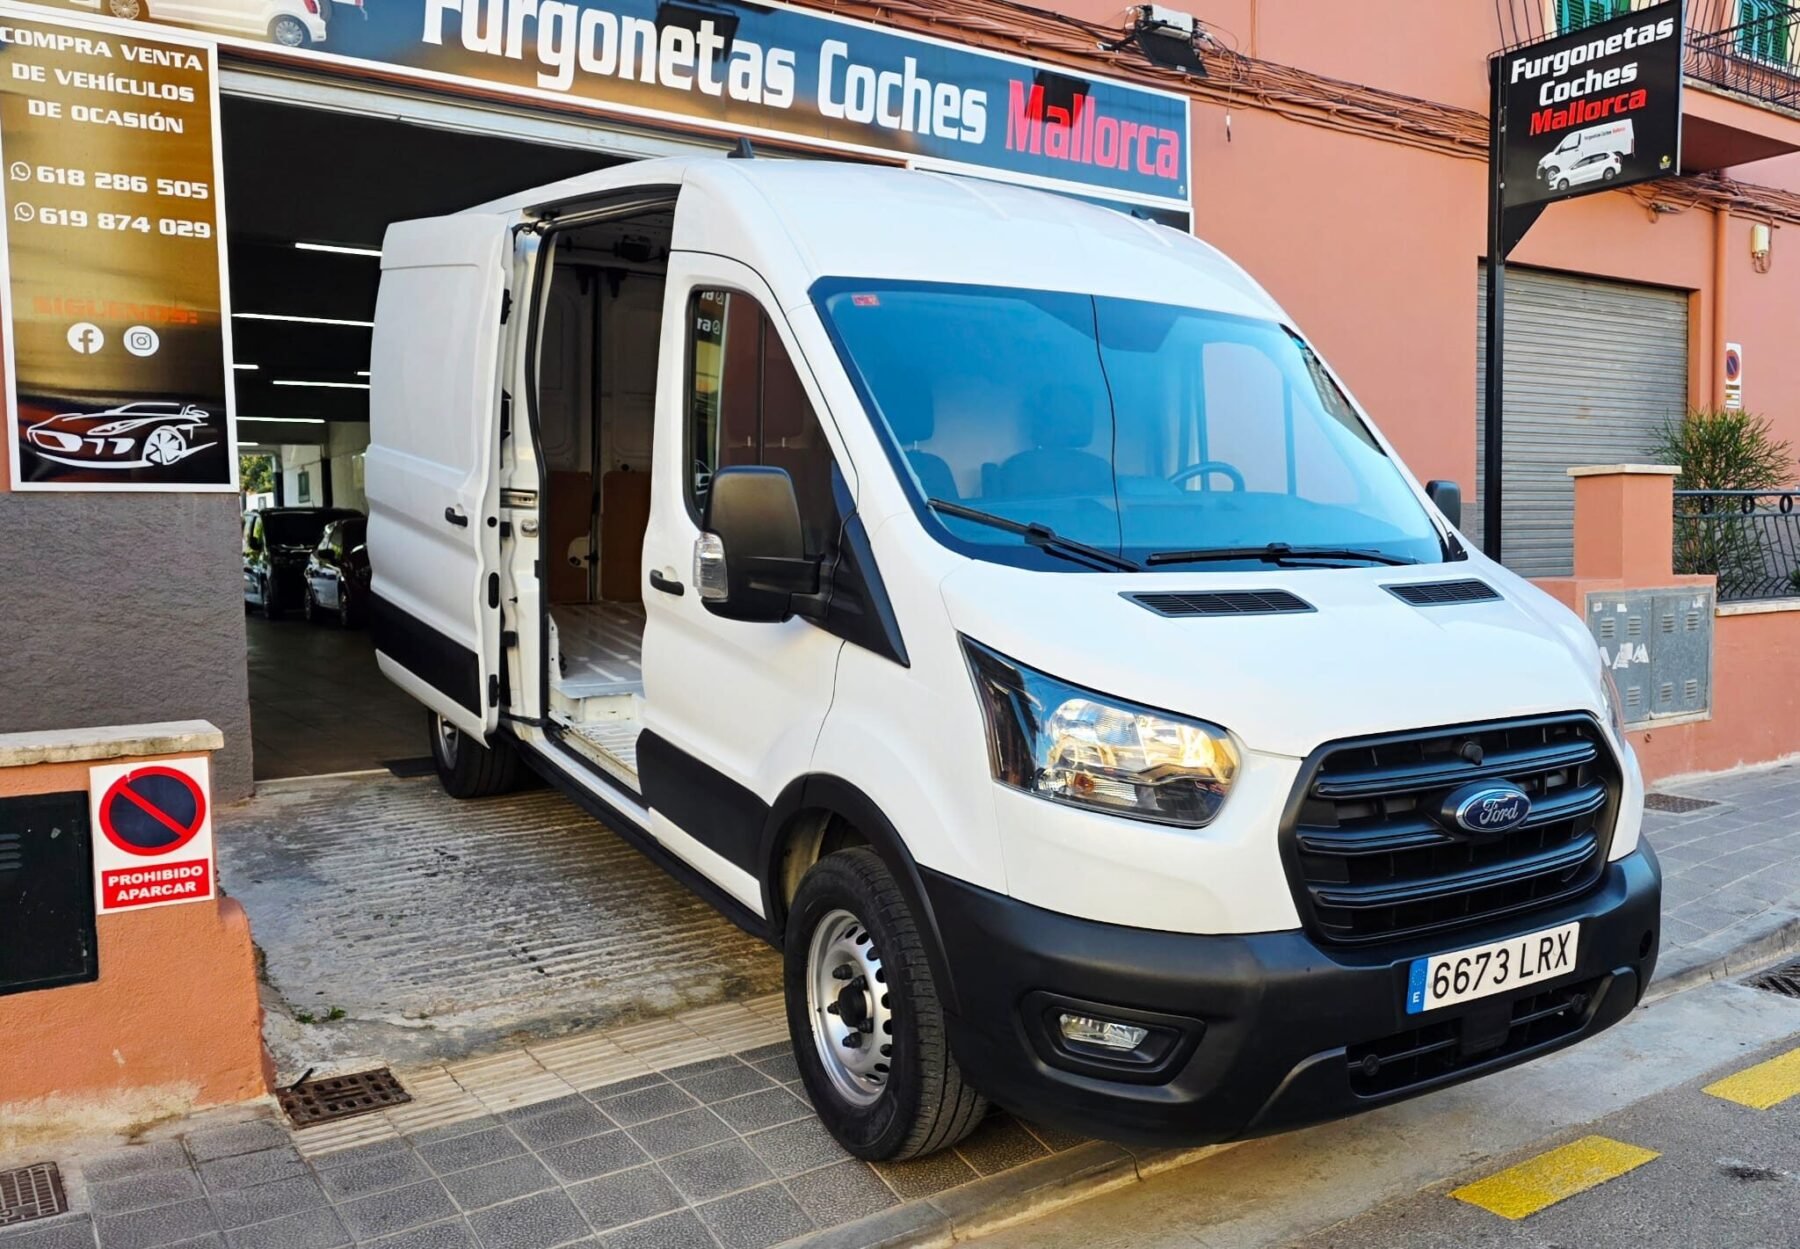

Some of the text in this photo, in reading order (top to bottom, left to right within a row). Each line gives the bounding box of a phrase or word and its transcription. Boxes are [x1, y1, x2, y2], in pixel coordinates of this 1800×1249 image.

[0, 26, 203, 71] COMPRA VENTA
[1510, 17, 1674, 84] Furgonetas
[11, 62, 195, 103] DE VEHÍCULOS
[1538, 62, 1638, 106] Coches
[27, 99, 184, 134] DE OCASIÓN
[817, 39, 988, 145] Coches
[1005, 79, 1180, 180] Mallorca
[1529, 88, 1648, 136] Mallorca
[36, 165, 209, 200] 618 286 505
[39, 207, 211, 239] 619 874 029
[1479, 797, 1519, 825] Ford
[107, 865, 204, 888] PROHIBIDO
[116, 881, 197, 902] APARCAR
[1432, 930, 1571, 999] 6673 LRX
[1412, 991, 1420, 1003] E
